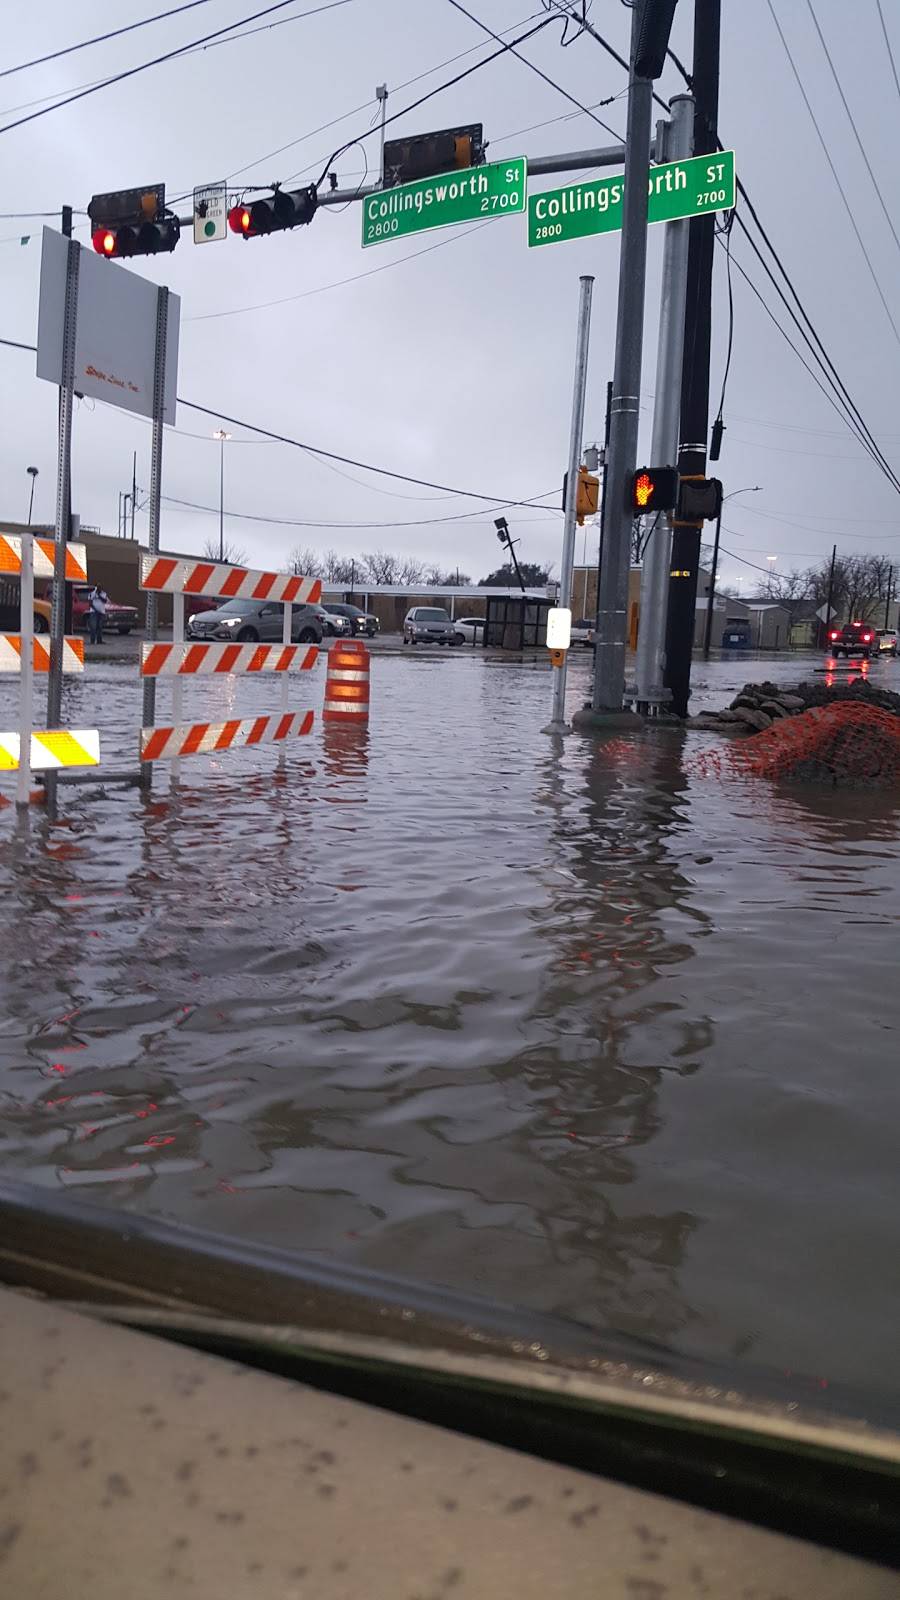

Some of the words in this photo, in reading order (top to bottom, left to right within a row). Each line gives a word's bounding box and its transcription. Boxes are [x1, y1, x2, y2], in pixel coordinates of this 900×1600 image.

[367, 218, 399, 239] 2800
[480, 192, 519, 211] 2700
[368, 173, 488, 220] Collingsworth
[505, 168, 519, 183] St
[535, 167, 687, 220] Collingsrth
[707, 164, 725, 183] ST
[535, 223, 562, 239] 2800
[697, 189, 726, 206] 2700
